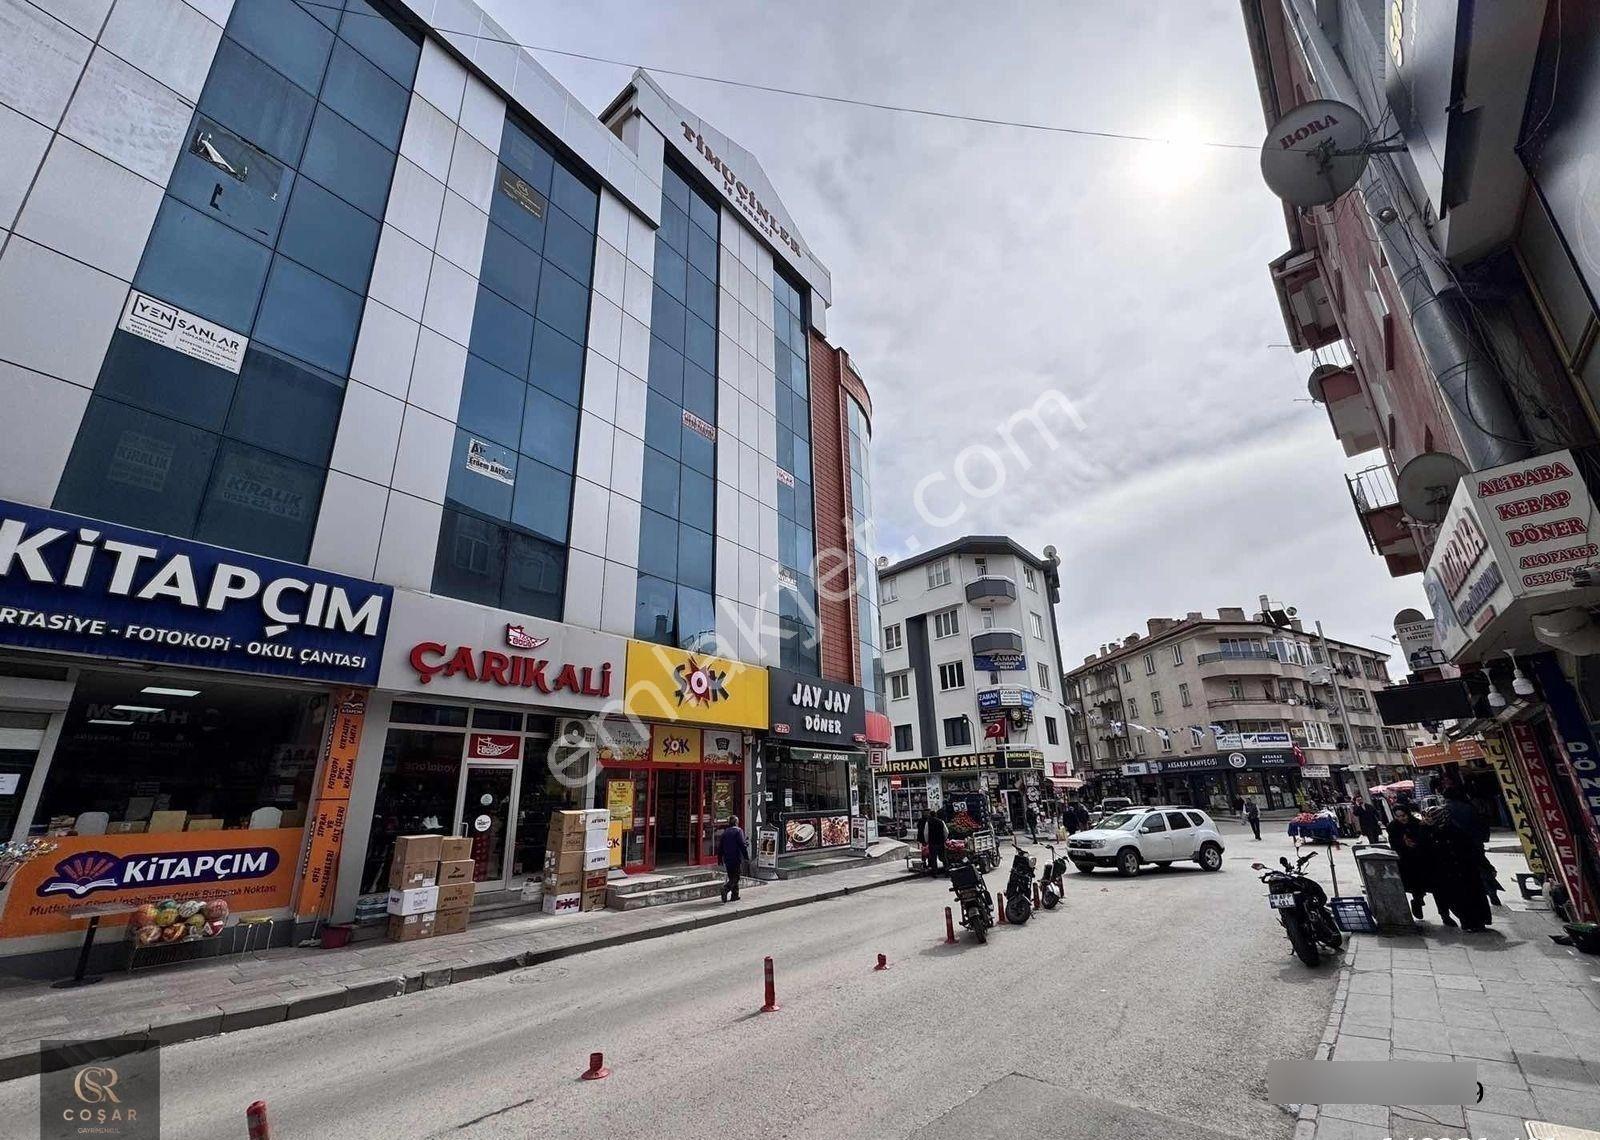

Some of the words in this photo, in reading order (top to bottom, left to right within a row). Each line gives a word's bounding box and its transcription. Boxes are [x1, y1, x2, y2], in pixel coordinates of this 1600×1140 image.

[1279, 114, 1339, 150] BORA
[681, 121, 801, 258] TİMUÇİNLER
[1478, 461, 1573, 498] ALİBABA
[1495, 489, 1572, 521] KEBAP
[1505, 517, 1588, 548] DÖNER
[0, 518, 384, 637] KİTAPÇIM
[125, 624, 231, 651] FOTOKOPİ
[247, 642, 295, 660] OKUL
[300, 648, 367, 669] ÇANTASI
[989, 654, 1023, 663] ZAMAN
[792, 682, 822, 710] JAY
[824, 689, 851, 714] JAY
[978, 691, 999, 702] ZAMAN
[804, 714, 842, 735] DÖNER
[812, 752, 822, 760] JAY
[872, 753, 881, 764] E
[939, 754, 996, 768] TİCARET
[606, 837, 621, 850] OK
[122, 850, 269, 884] KİTAPÇIM
[243, 883, 278, 897] Noktası
